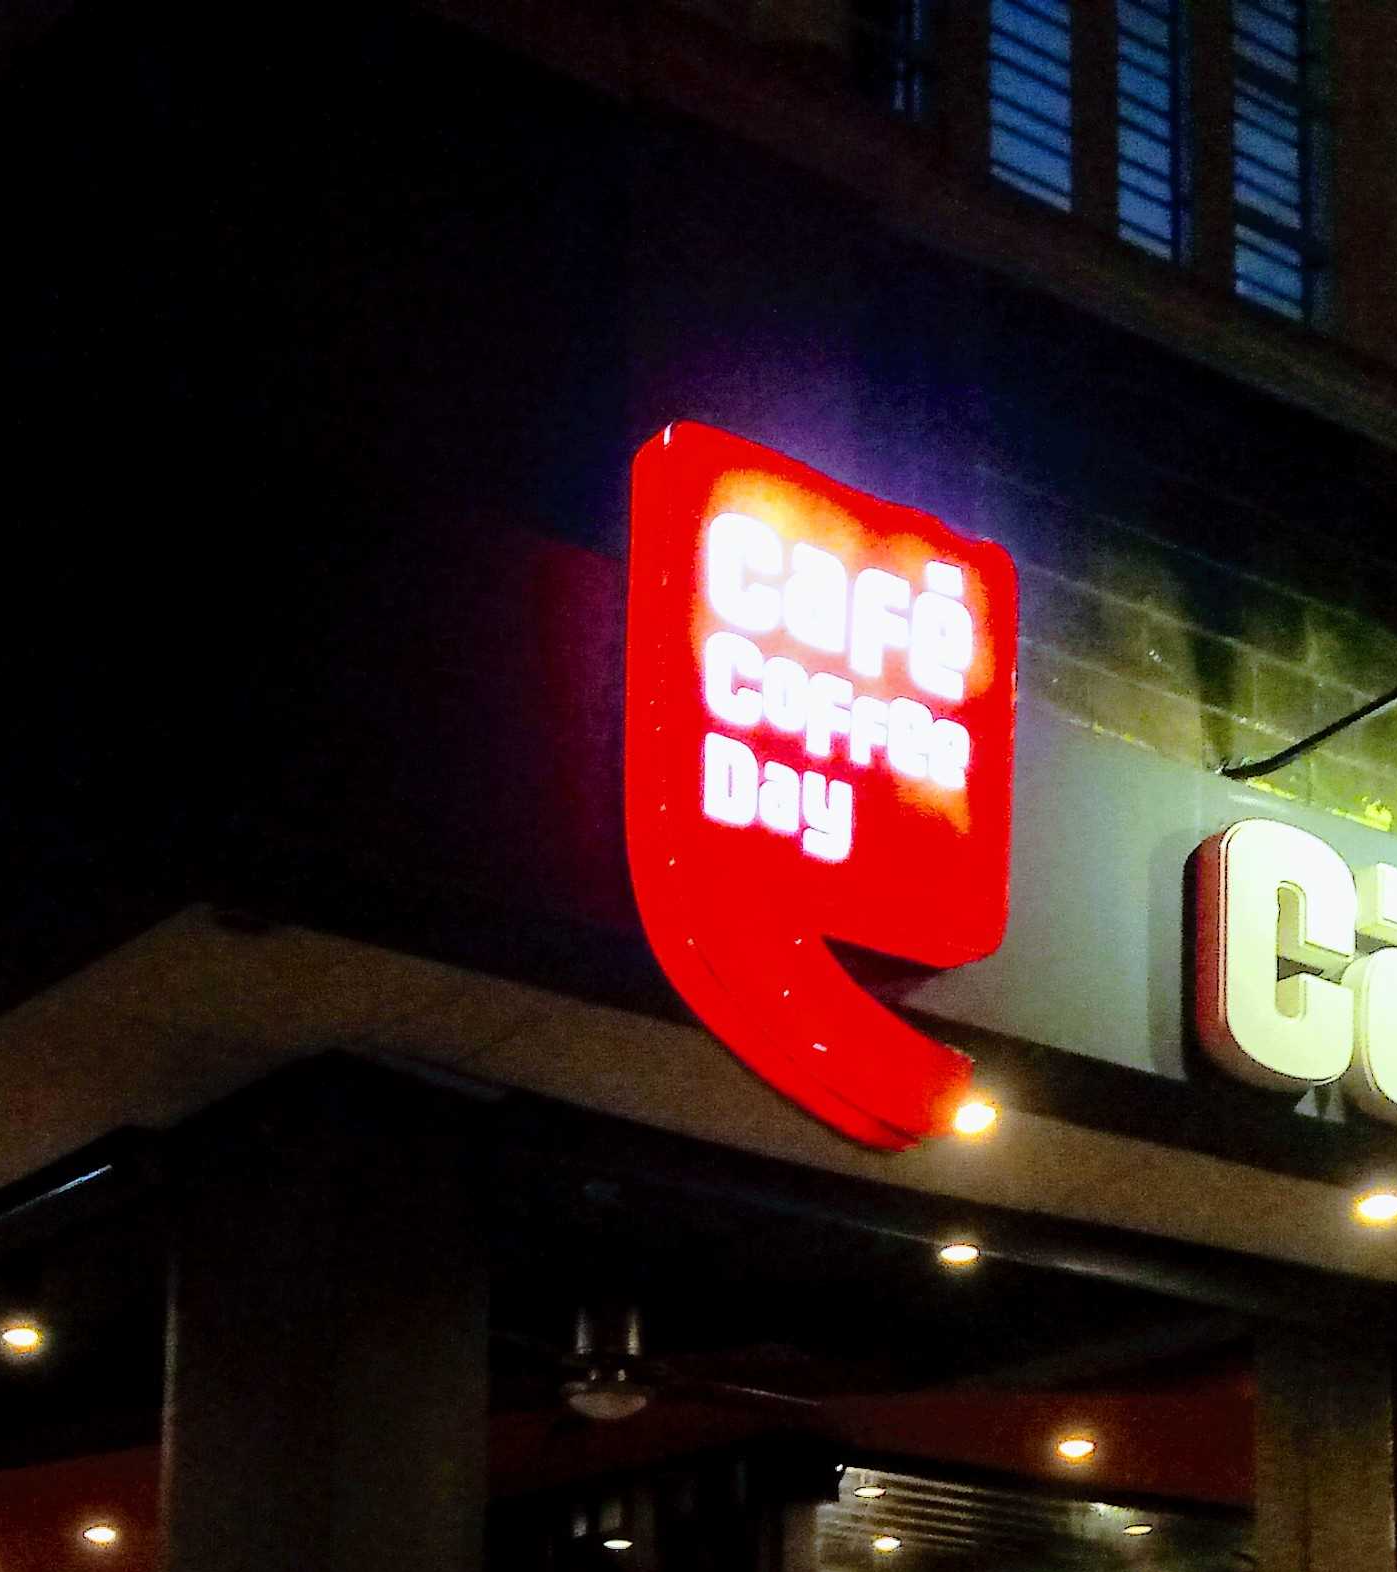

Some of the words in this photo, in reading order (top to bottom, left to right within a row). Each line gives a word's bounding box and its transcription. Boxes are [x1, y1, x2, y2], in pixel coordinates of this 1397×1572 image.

[707, 512, 973, 699] Café
[705, 632, 970, 789] Coffee
[704, 732, 853, 862] Day
